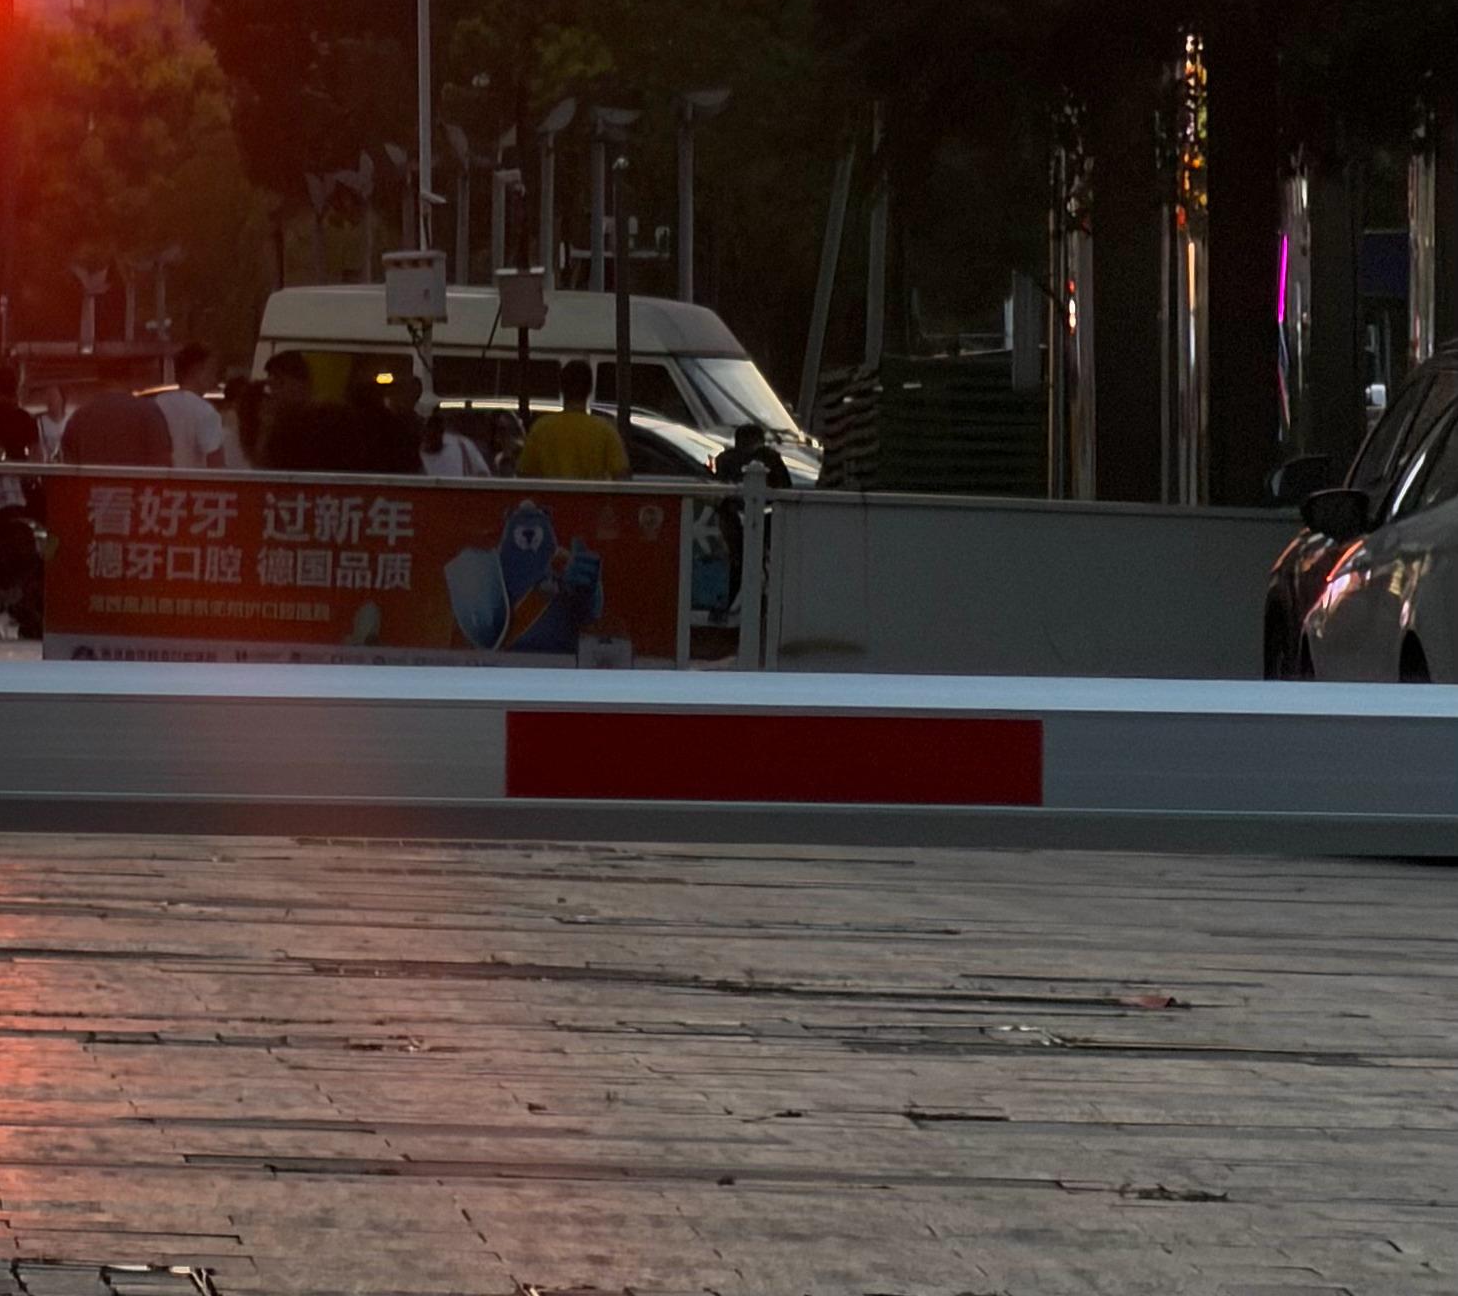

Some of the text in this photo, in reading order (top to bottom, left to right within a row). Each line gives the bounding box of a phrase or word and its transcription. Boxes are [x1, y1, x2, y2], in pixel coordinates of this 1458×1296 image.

[86, 486, 415, 546] 看好牙 过新年
[86, 540, 413, 591] 德牙口腔 德国品质
